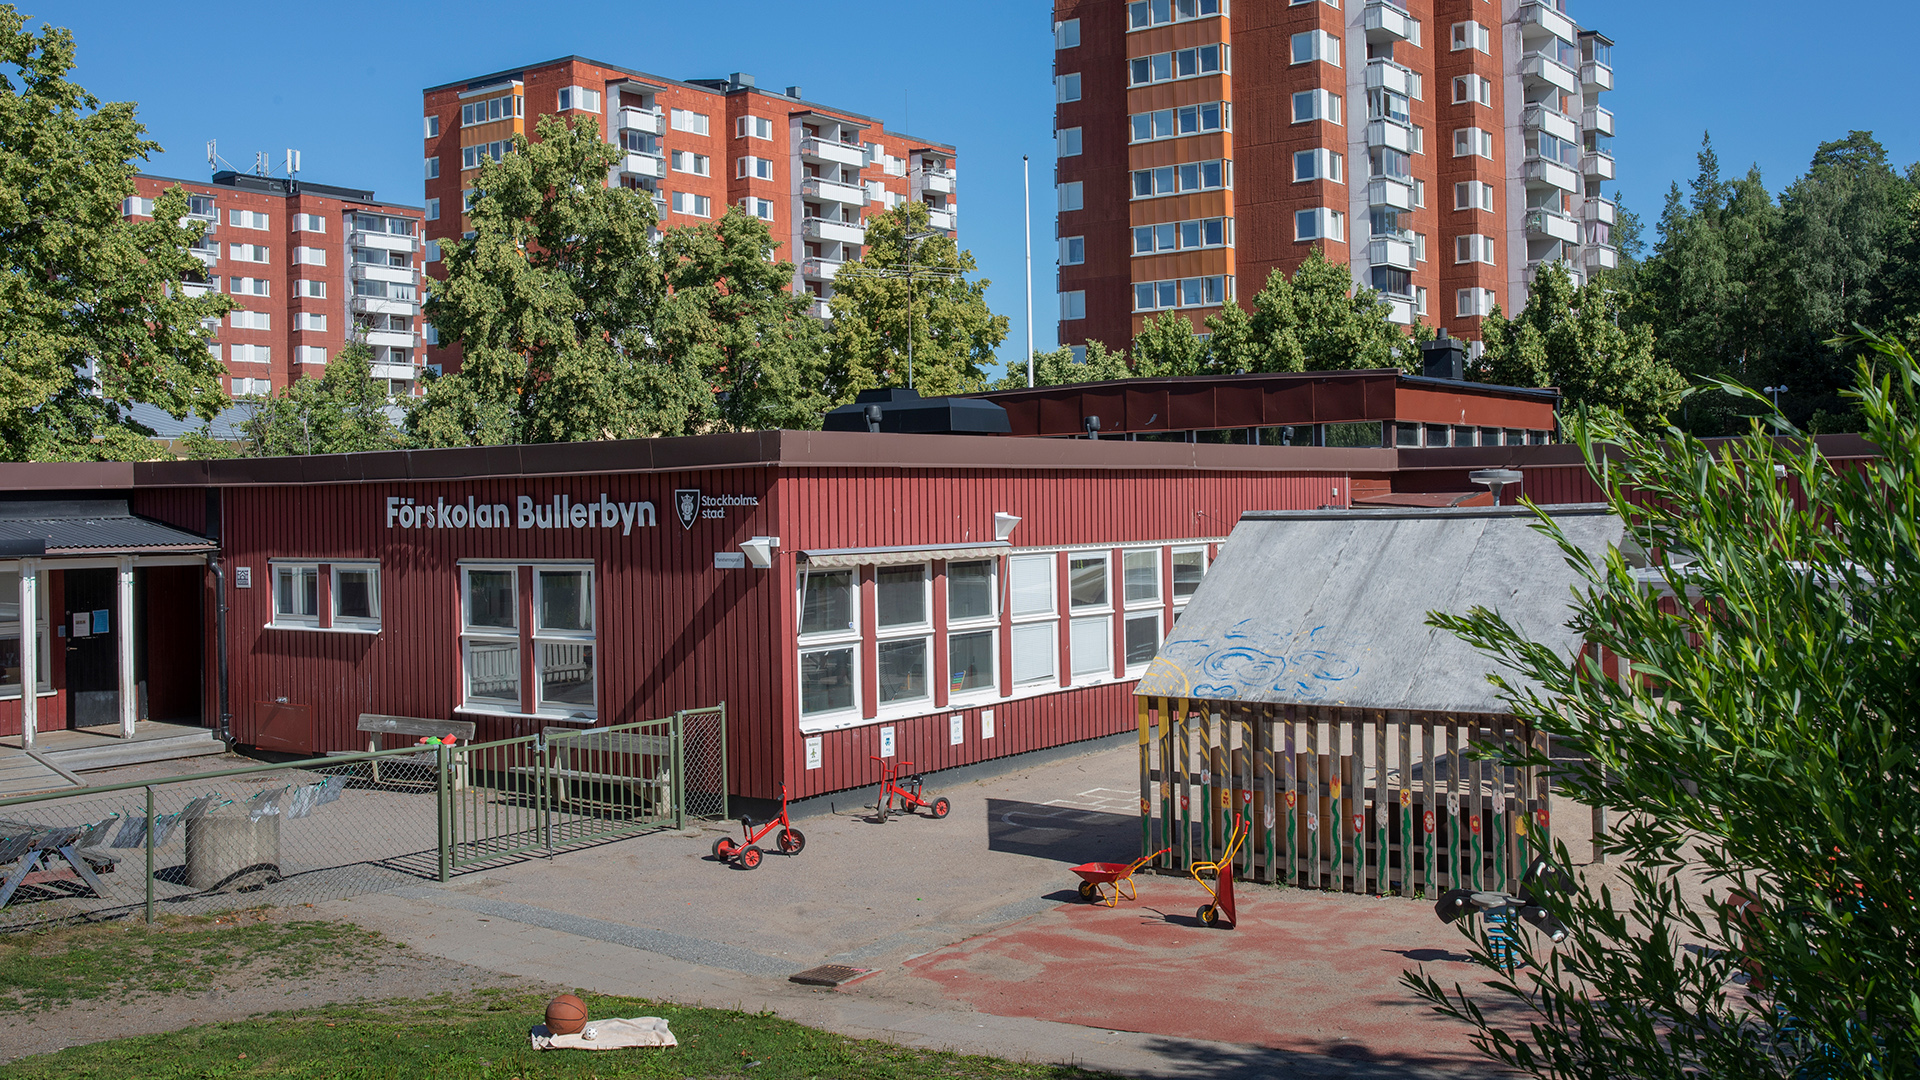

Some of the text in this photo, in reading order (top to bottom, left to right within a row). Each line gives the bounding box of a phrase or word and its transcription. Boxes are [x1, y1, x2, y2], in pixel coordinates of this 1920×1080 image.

[701, 494, 758, 506] Stockholms
[386, 493, 656, 536] Förskolan Bullerbyn
[701, 507, 725, 519] stad
